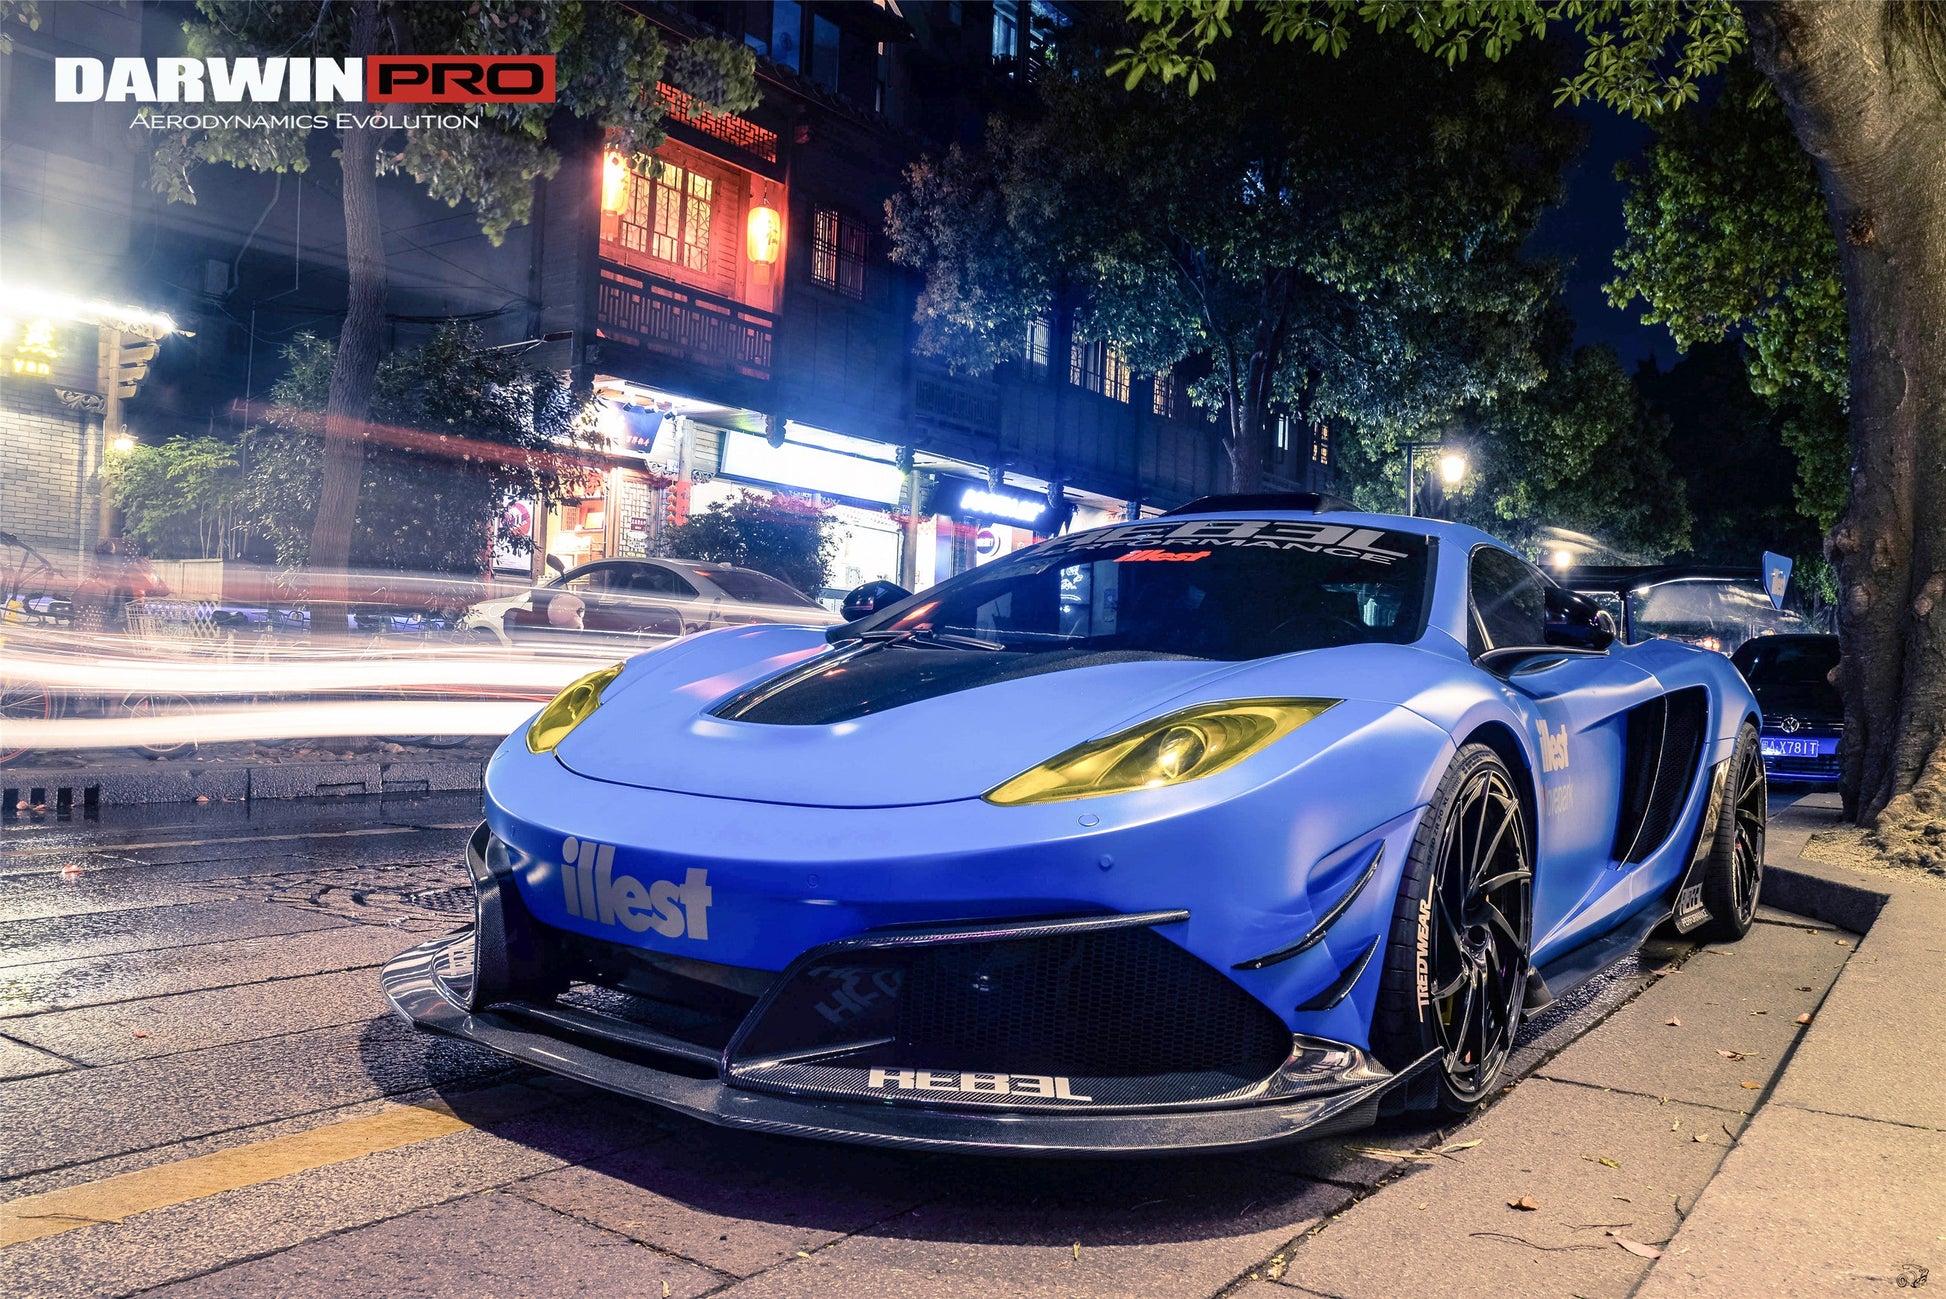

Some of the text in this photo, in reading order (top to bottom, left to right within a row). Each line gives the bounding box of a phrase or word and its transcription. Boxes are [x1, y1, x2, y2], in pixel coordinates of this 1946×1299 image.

[1113, 549, 1211, 562] illest
[1536, 719, 1569, 773] illest
[561, 836, 713, 941] illest
[1416, 874, 1435, 1023] TREDWEAR
